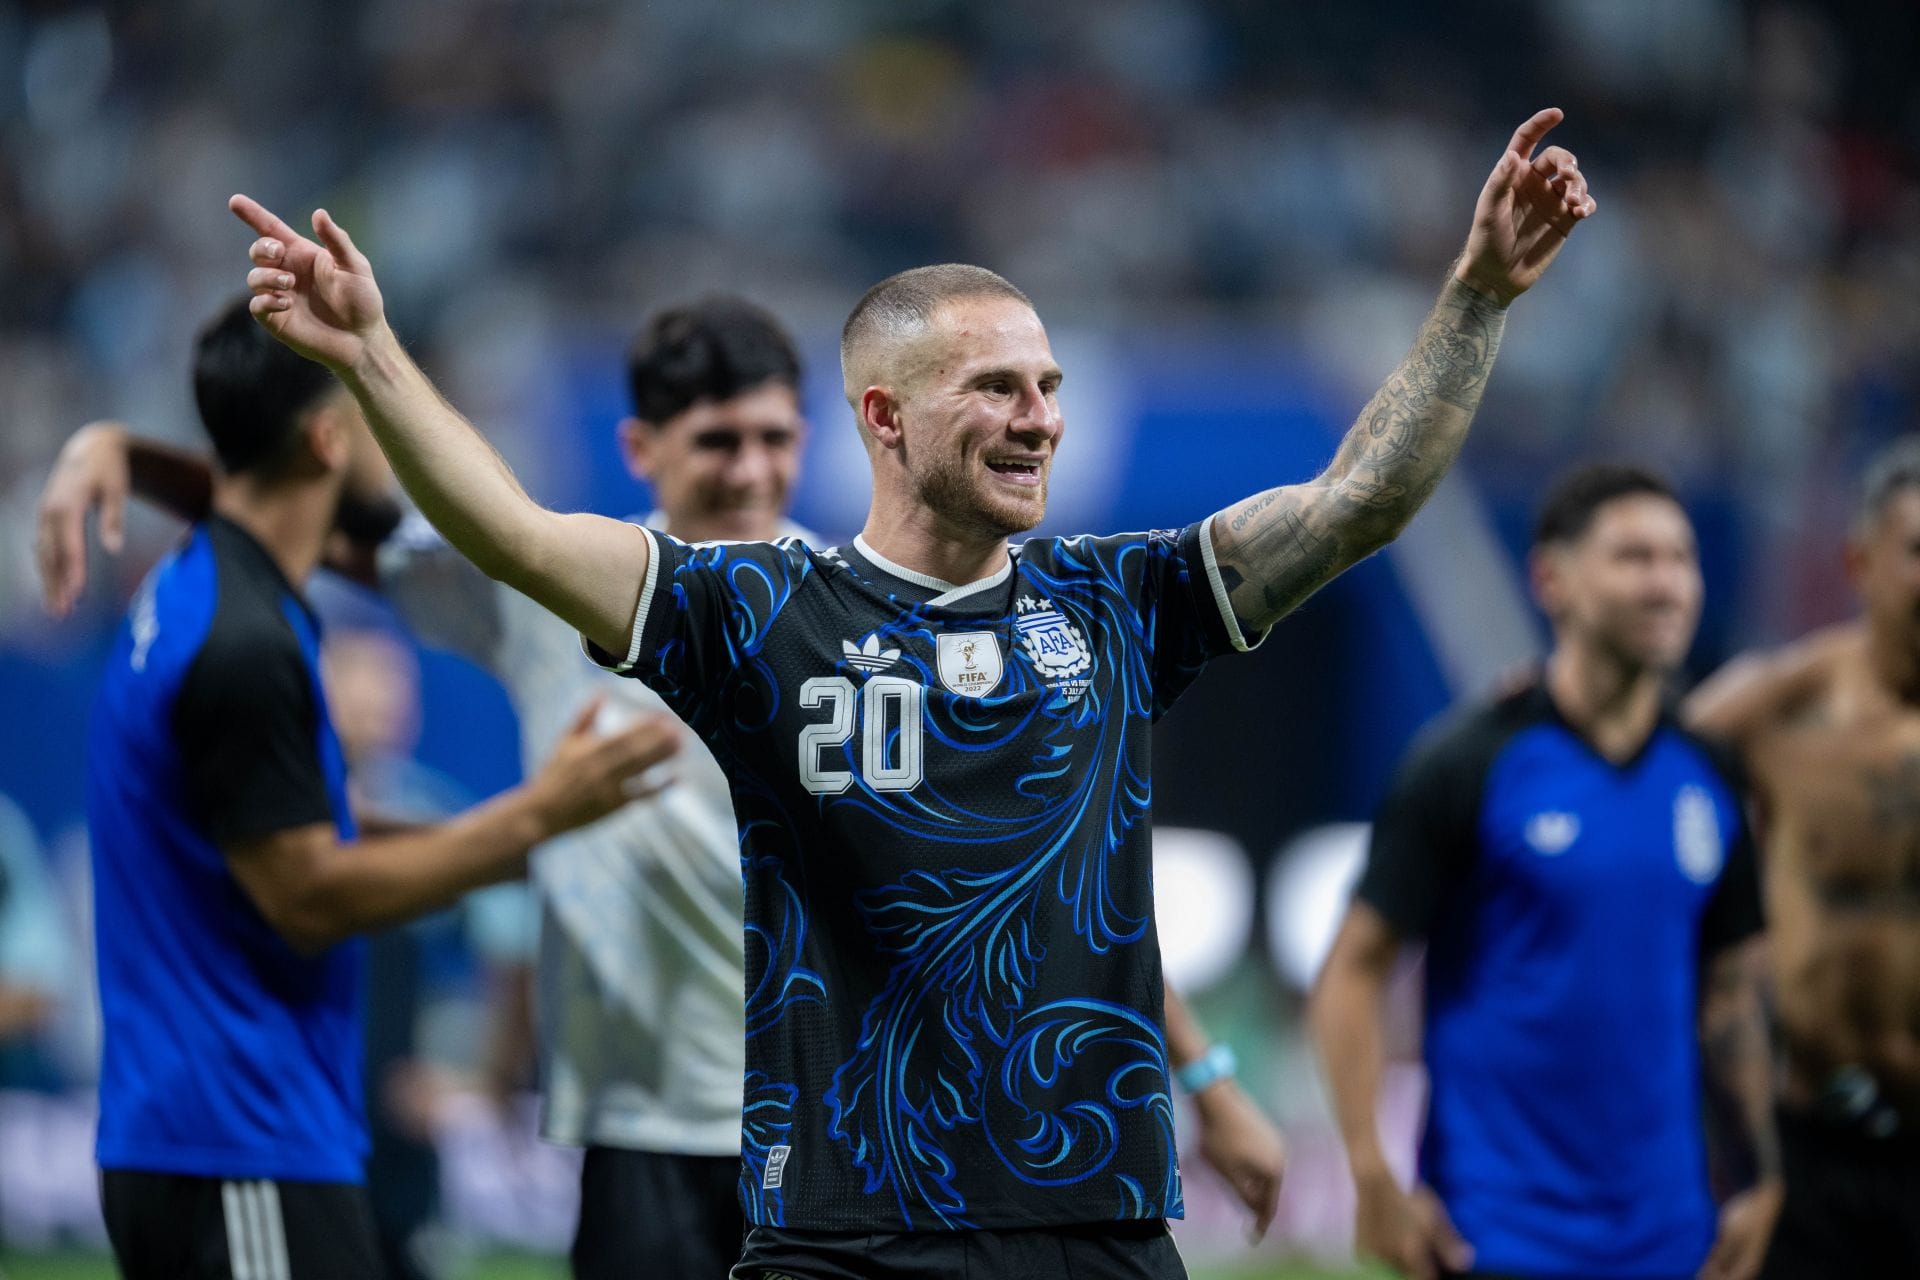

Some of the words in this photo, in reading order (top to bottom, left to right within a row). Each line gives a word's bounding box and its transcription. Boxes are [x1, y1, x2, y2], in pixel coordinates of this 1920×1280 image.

[1036, 627, 1074, 656] AFA
[958, 672, 986, 683] FIFA
[798, 676, 923, 796] 20
